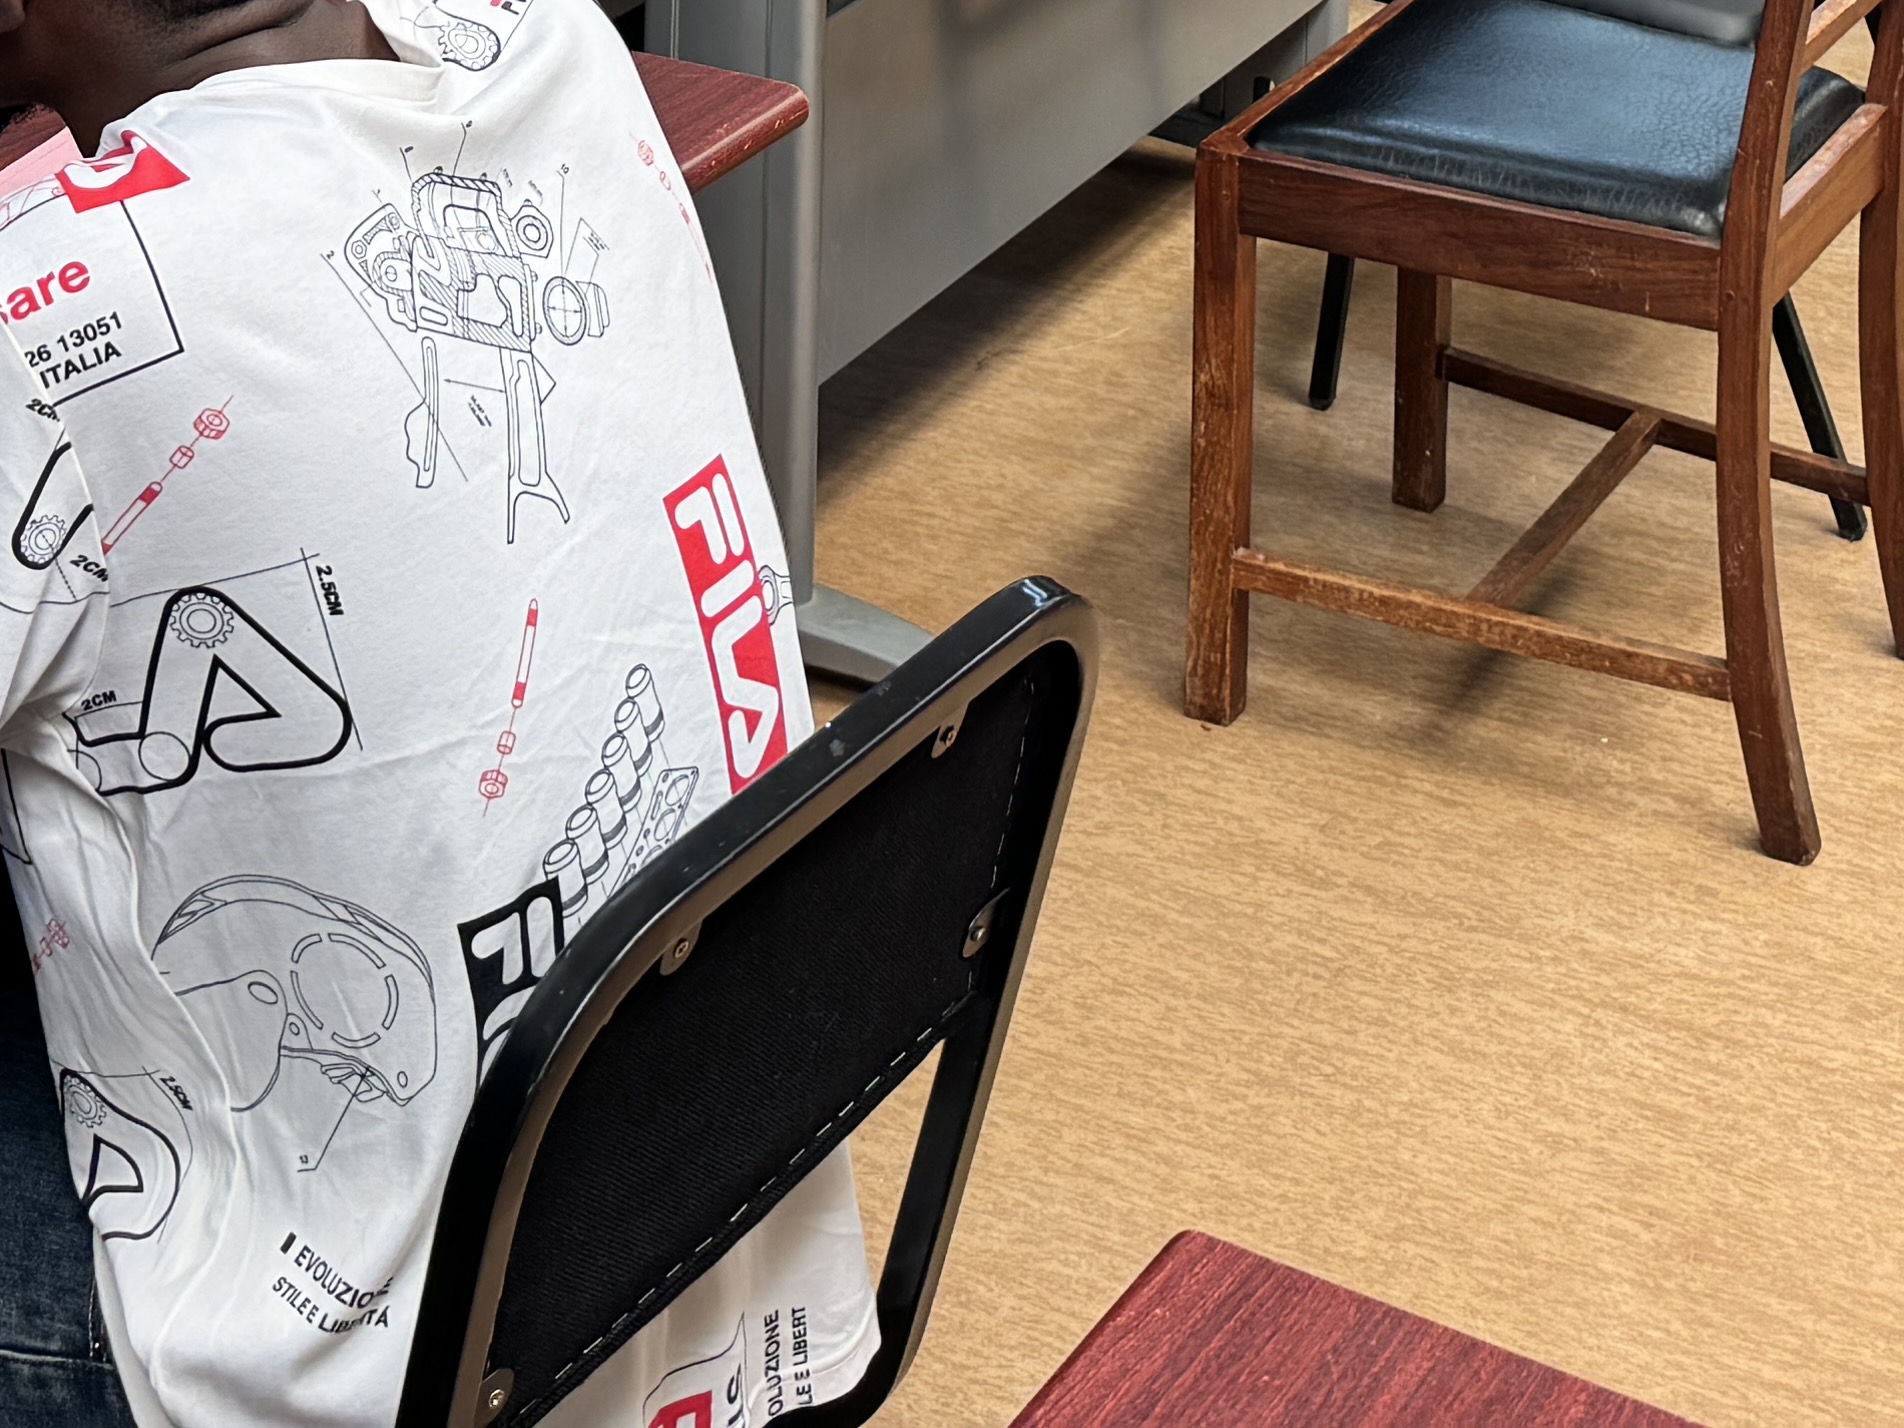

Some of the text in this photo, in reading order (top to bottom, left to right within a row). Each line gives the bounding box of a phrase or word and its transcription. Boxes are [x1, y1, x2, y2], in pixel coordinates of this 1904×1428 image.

[57, 311, 123, 354] 13051
[39, 342, 123, 389] ITALIA
[315, 564, 344, 617] 2.5CM
[674, 478, 783, 779] FILA
[81, 690, 117, 711] 2CM
[272, 1276, 305, 1316] STILE
[764, 1309, 784, 1417] OLUZIONE
